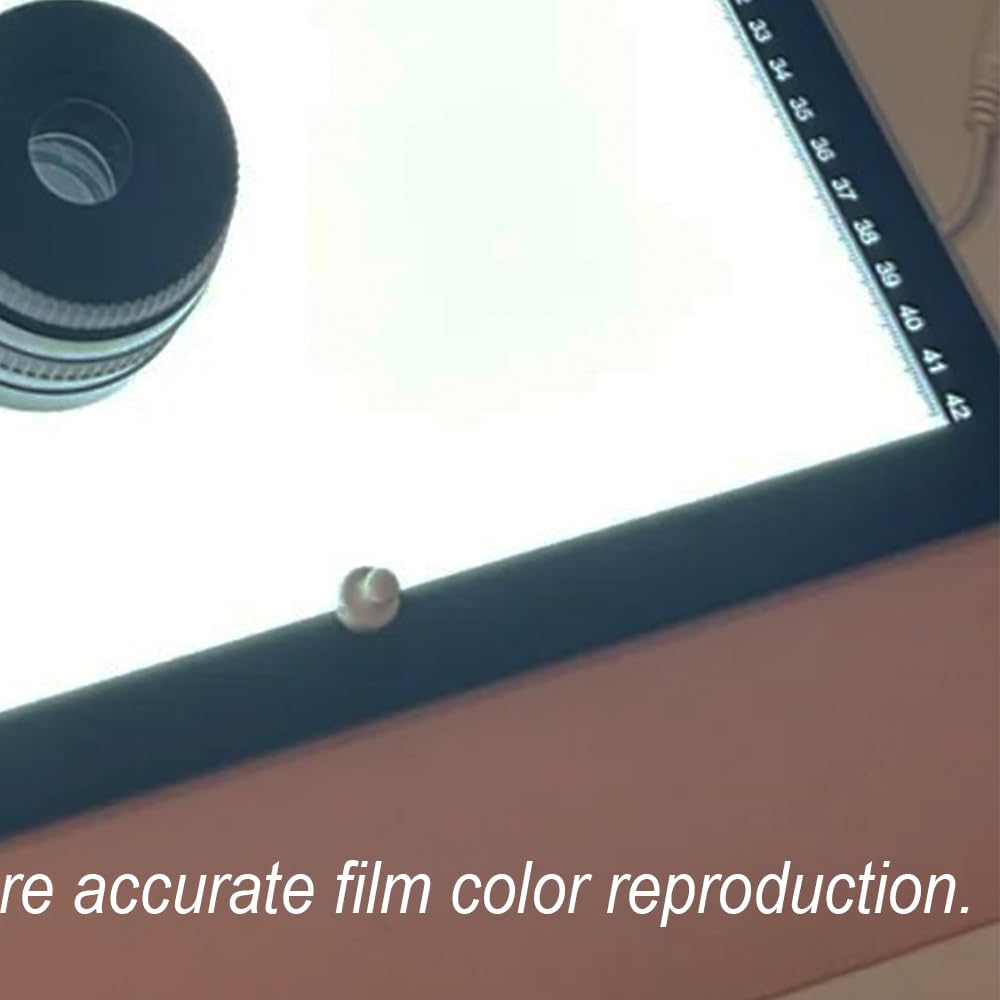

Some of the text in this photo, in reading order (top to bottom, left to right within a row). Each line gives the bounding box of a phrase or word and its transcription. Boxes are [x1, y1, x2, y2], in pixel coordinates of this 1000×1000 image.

[747, 18, 773, 44] 33
[767, 57, 794, 83] 34
[788, 96, 815, 123] 35
[809, 136, 836, 163] 36
[830, 177, 859, 202] 37
[852, 218, 881, 247] 38
[874, 260, 903, 289] 39
[899, 304, 926, 333] 40
[921, 348, 948, 375] 41
[945, 393, 973, 423] 42
